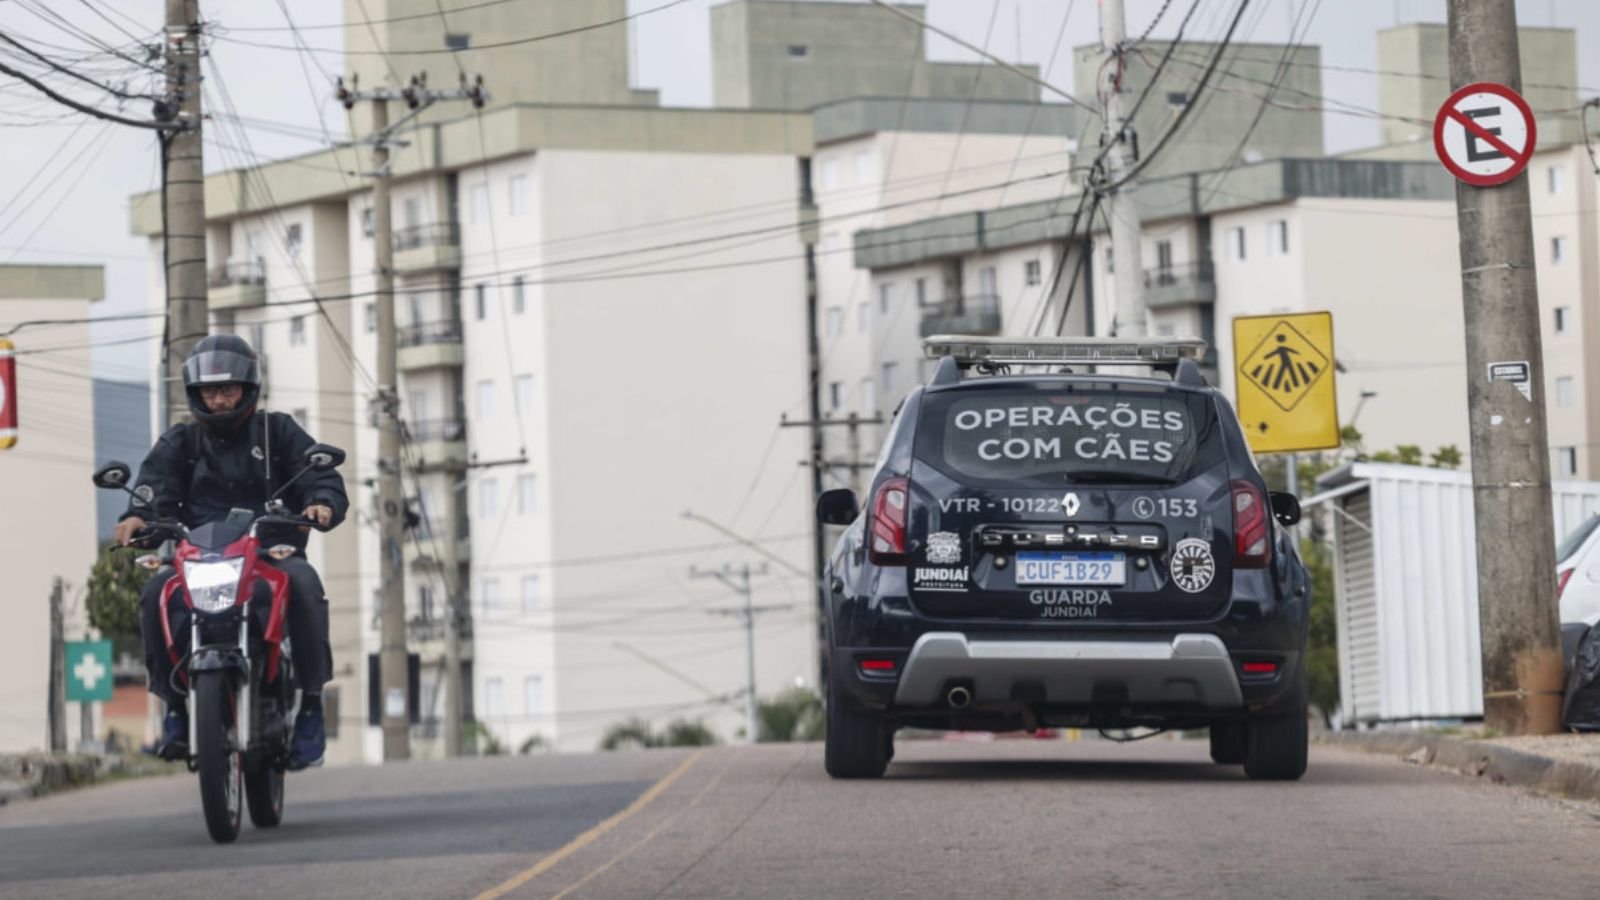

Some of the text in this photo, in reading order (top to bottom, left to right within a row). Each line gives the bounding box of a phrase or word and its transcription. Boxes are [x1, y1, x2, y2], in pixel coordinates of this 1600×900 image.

[1463, 106, 1508, 162] E
[954, 403, 1184, 431] OPERAÇÕES
[978, 433, 1173, 463] COM CÃES
[939, 498, 980, 513] VTR
[1003, 498, 1060, 512] 10122
[1160, 498, 1198, 517] 153
[913, 565, 969, 583] JUNDIAÍ
[1026, 562, 1112, 580] CUF1B29
[1030, 590, 1112, 605] GUARDA
[1041, 606, 1098, 618] JUNDIAÍ
